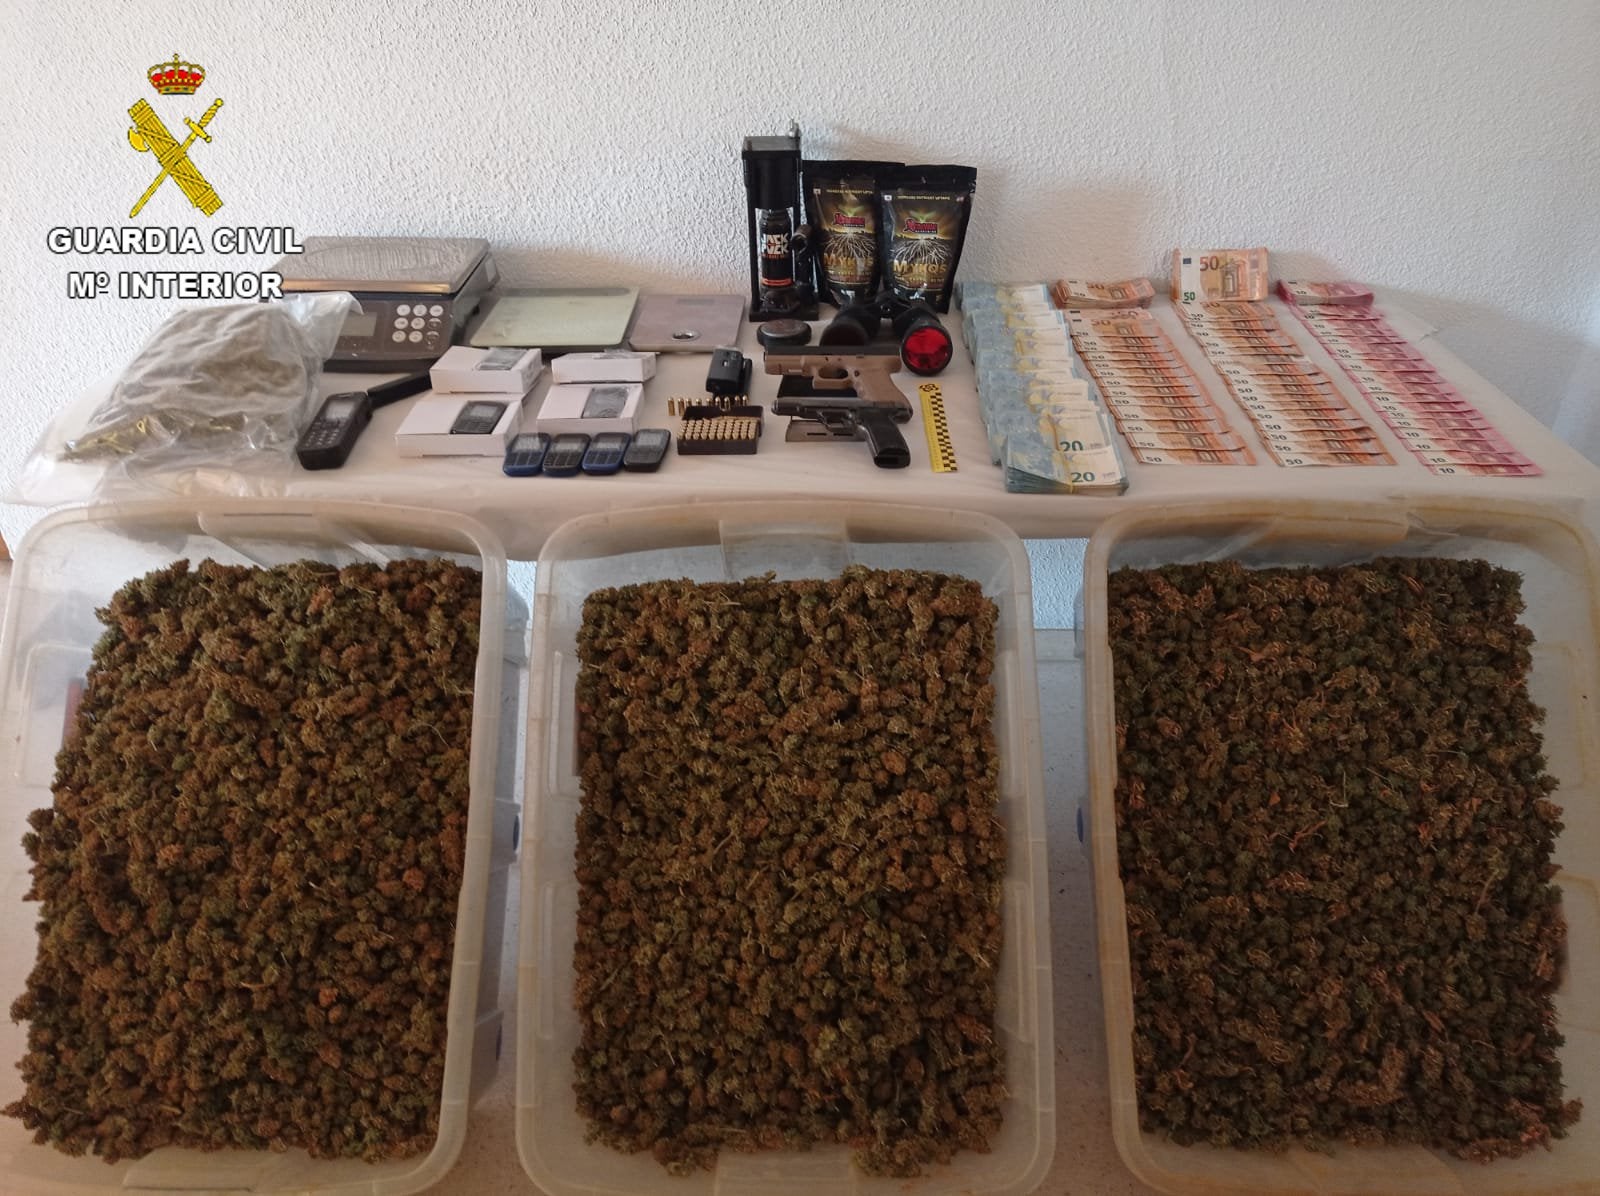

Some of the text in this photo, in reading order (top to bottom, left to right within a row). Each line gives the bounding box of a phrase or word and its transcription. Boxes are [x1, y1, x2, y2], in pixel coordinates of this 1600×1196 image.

[1199, 255, 1220, 272] 50
[1183, 291, 1196, 301] 50
[1059, 440, 1084, 452] 20
[1070, 471, 1096, 483] 20
